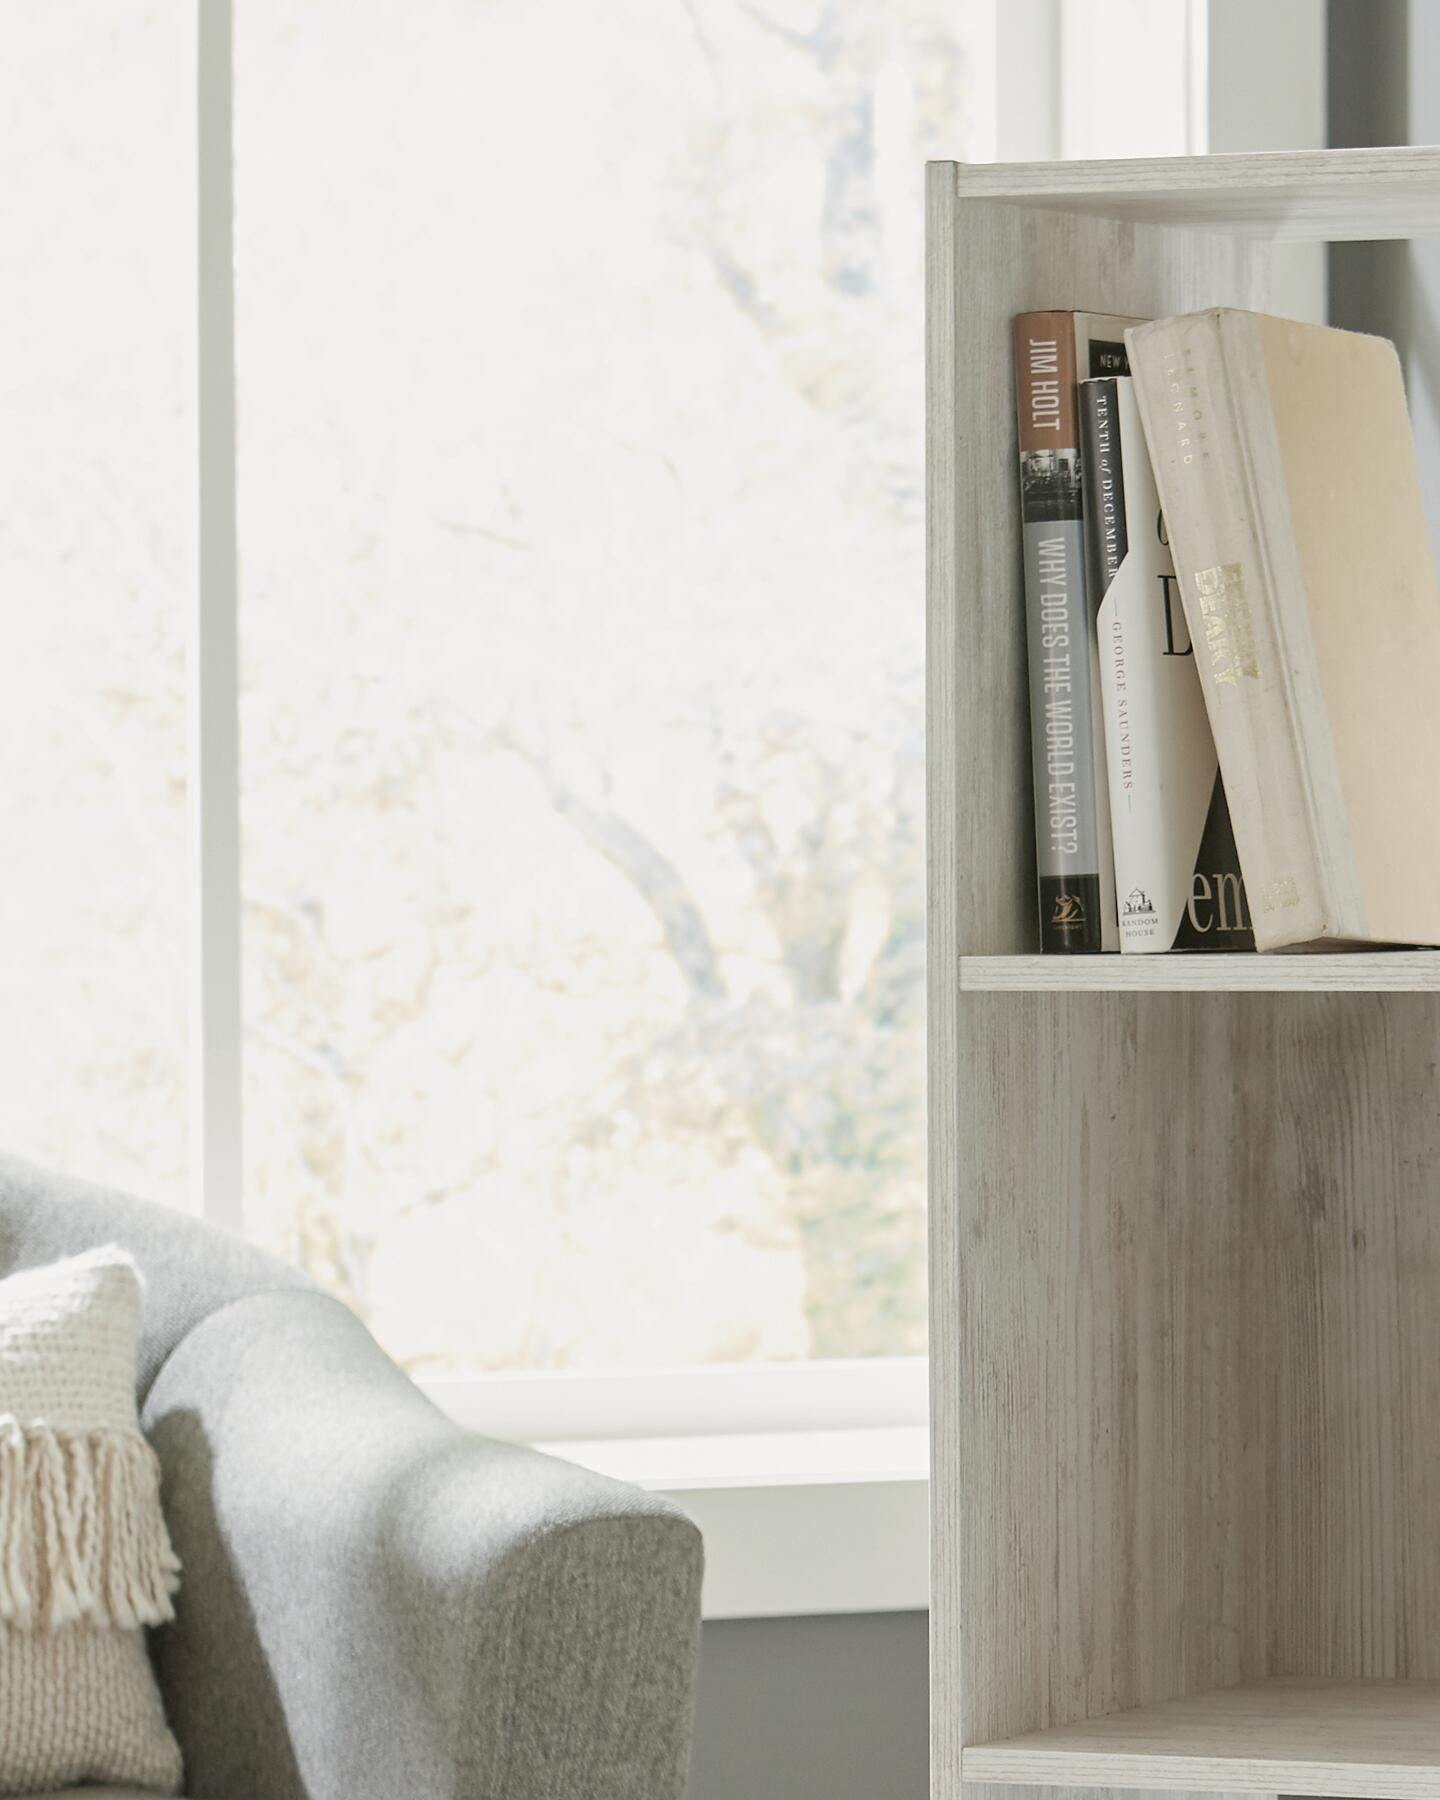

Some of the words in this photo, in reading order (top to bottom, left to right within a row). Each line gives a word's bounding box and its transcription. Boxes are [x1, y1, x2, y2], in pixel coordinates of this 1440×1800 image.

[1029, 338, 1058, 374] JIM
[1100, 353, 1121, 369] NEW
[1031, 380, 1061, 431] HOLT
[1096, 394, 1111, 454] TENTH
[1100, 459, 1111, 474] of
[1101, 479, 1119, 579] DECEMBER
[1038, 537, 1067, 588] WHY
[1040, 593, 1069, 649] DOES
[1043, 653, 1071, 693] THE
[1112, 621, 1127, 692] GEORGE
[1044, 699, 1076, 777] WORLD
[1118, 699, 1134, 790] SAUNDERS
[1047, 783, 1078, 854] EXIST?
[1121, 917, 1159, 928] RANDOM
[1125, 928, 1155, 938] HOUSE
